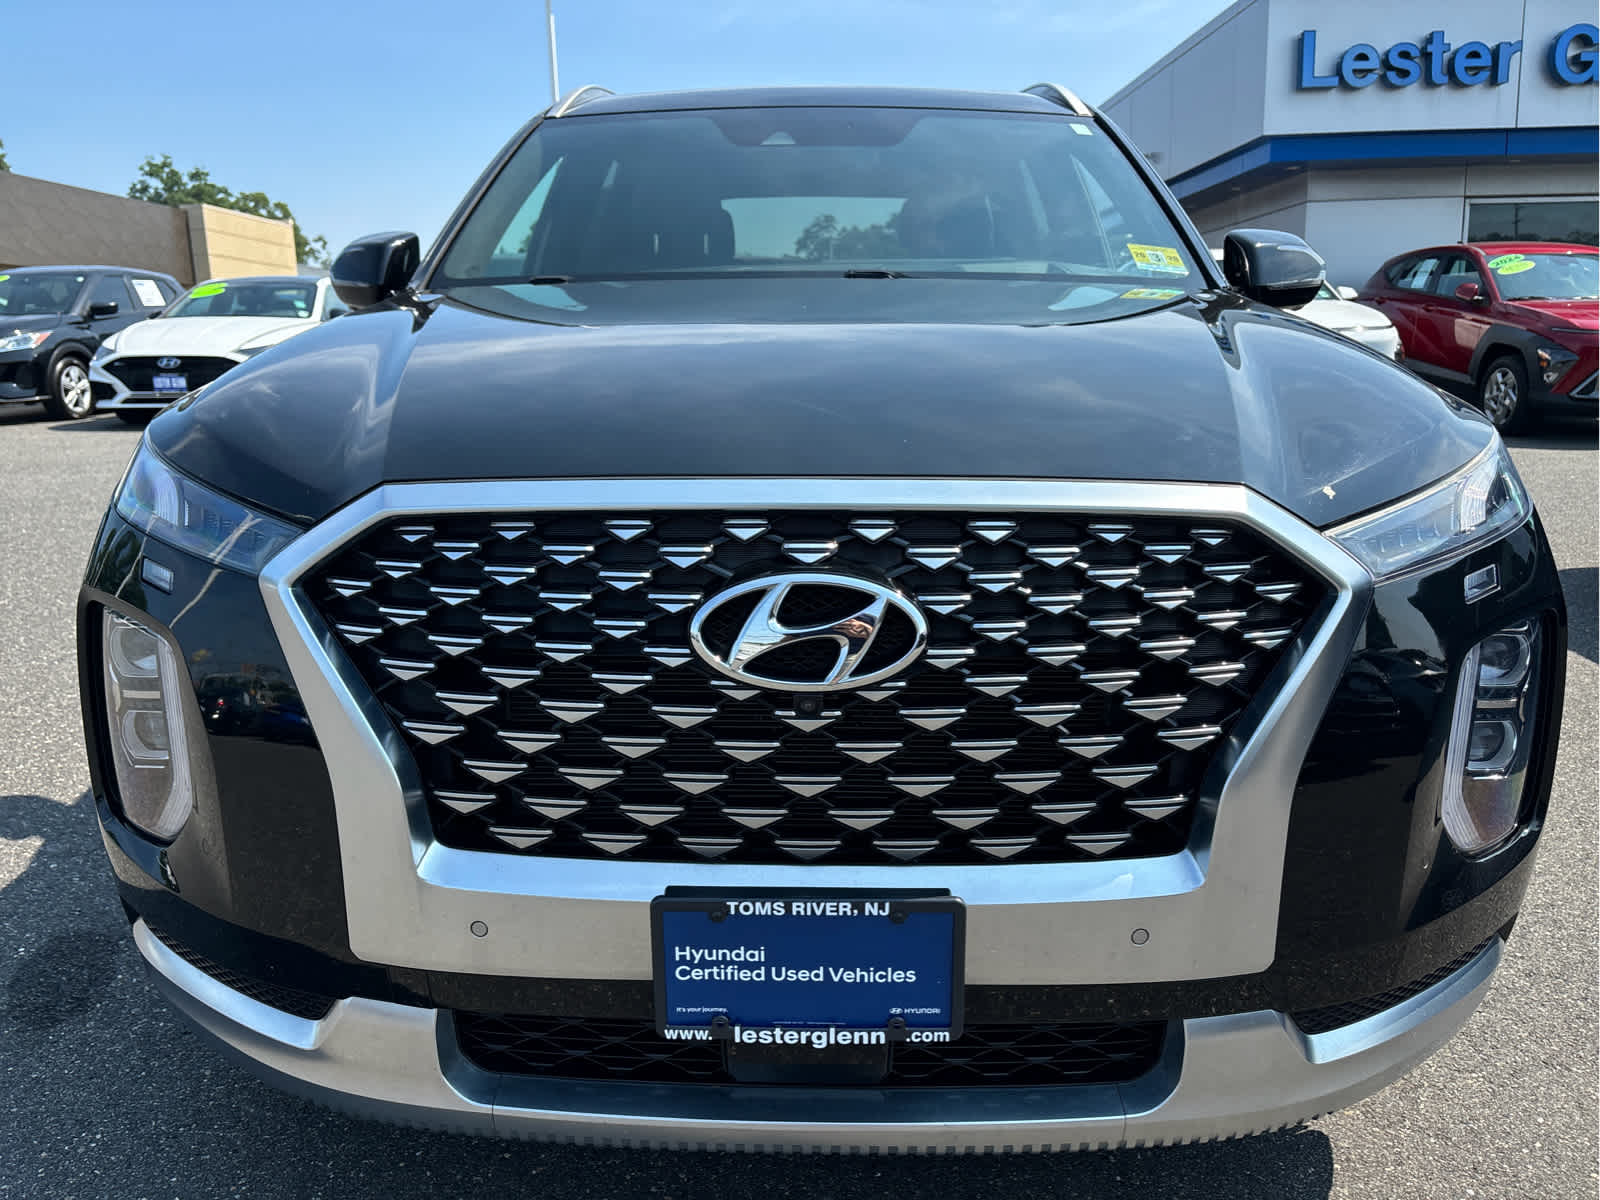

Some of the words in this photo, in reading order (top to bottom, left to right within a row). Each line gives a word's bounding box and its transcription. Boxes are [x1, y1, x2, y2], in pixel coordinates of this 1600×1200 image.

[1299, 29, 1523, 88] Lester
[726, 901, 785, 916] TOMS
[792, 901, 859, 917] RIVER,
[865, 902, 890, 917] NJ
[675, 946, 765, 964] Hyundai
[675, 965, 765, 981] Certified
[771, 966, 824, 982] Used
[829, 967, 917, 983] Vehicles
[664, 1029, 713, 1041] www.
[734, 1026, 886, 1049] lesterglenn
[905, 1031, 950, 1043] .com
